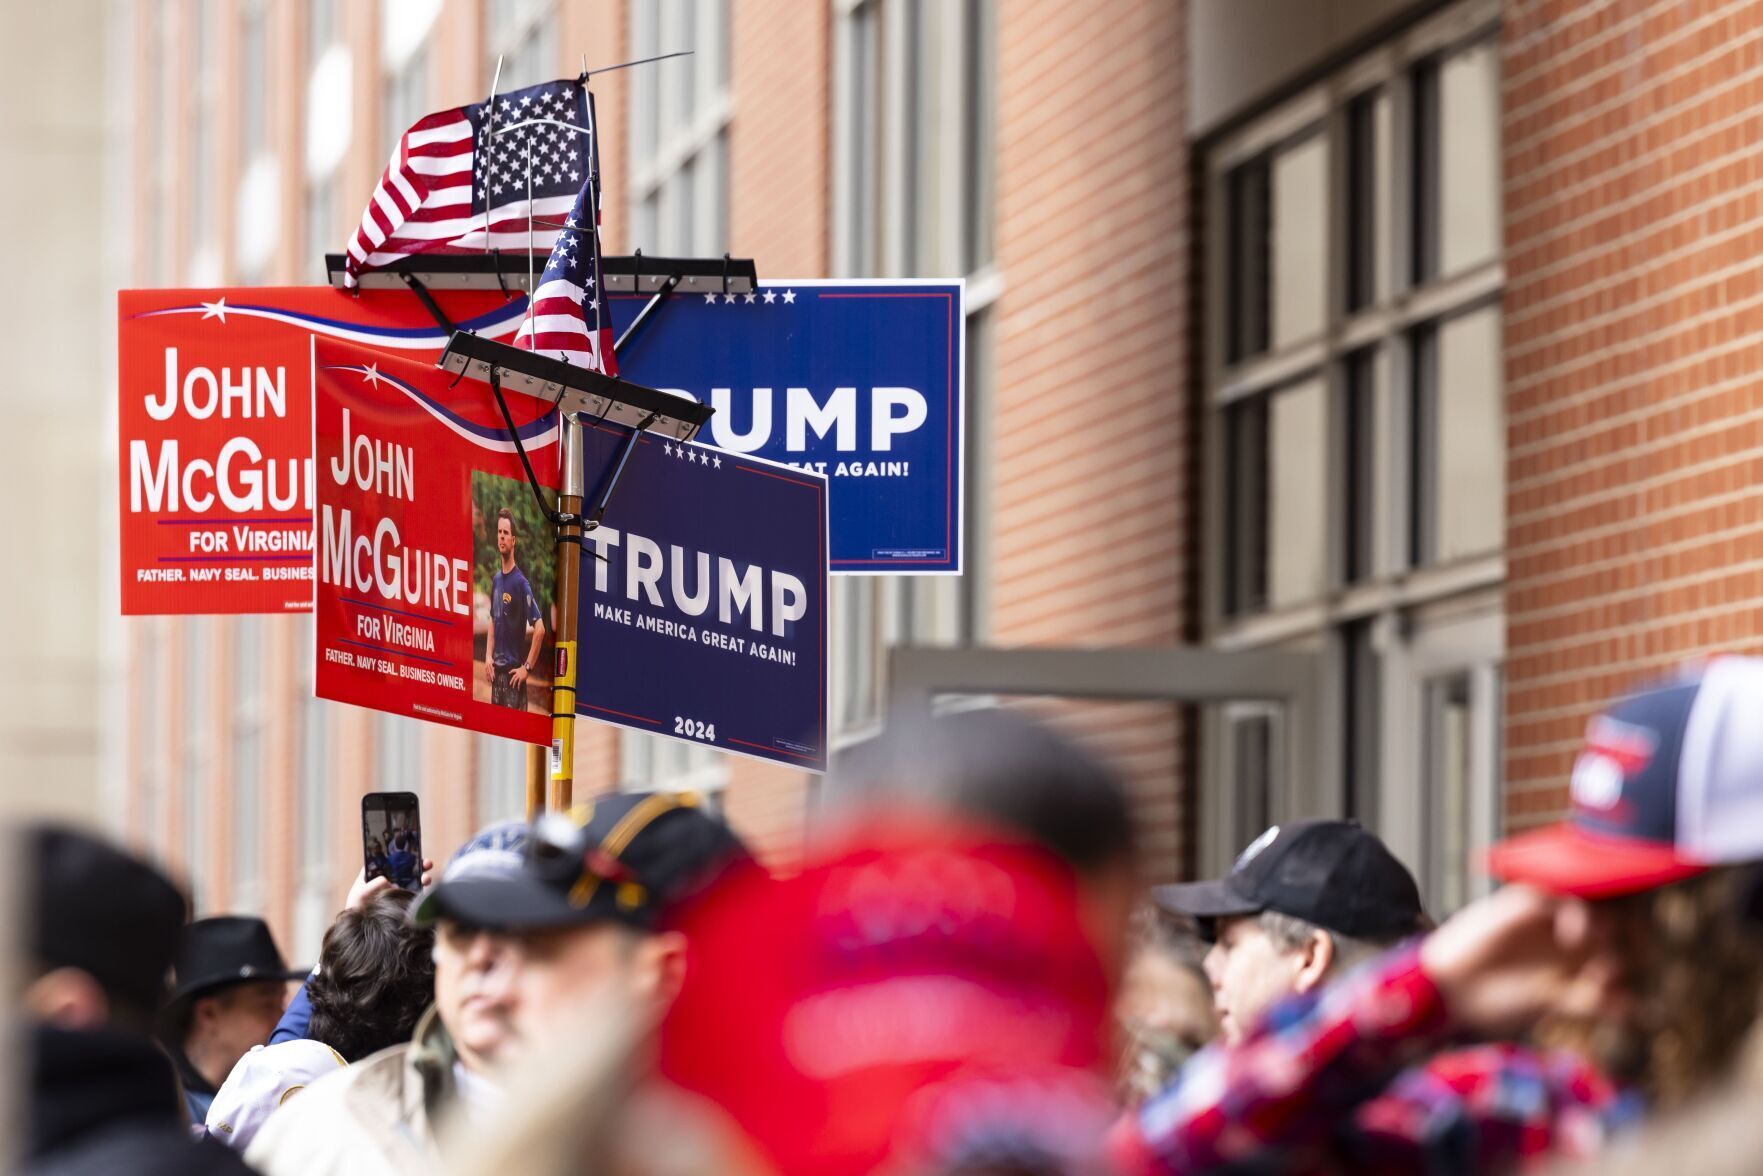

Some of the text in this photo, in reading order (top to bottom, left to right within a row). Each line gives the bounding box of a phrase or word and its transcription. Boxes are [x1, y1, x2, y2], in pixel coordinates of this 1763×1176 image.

[144, 347, 286, 421] JOHN
[655, 387, 928, 452] UMP
[331, 407, 414, 502] JOHN
[834, 462, 909, 477] AGAIN!
[190, 531, 229, 552] FOR
[322, 504, 470, 616] McGUIRE
[137, 567, 313, 582] FATHER. NAVY SEAL. BUSINES
[585, 525, 808, 637] TRUMP
[357, 614, 435, 652] FOR VIRGINIA
[594, 603, 796, 666] MAKE AMERICA GREAT AGAIN!
[325, 648, 466, 691] FATHER. NAVY SEAL. BUSINESS OWNER.
[674, 716, 716, 742] 2024
